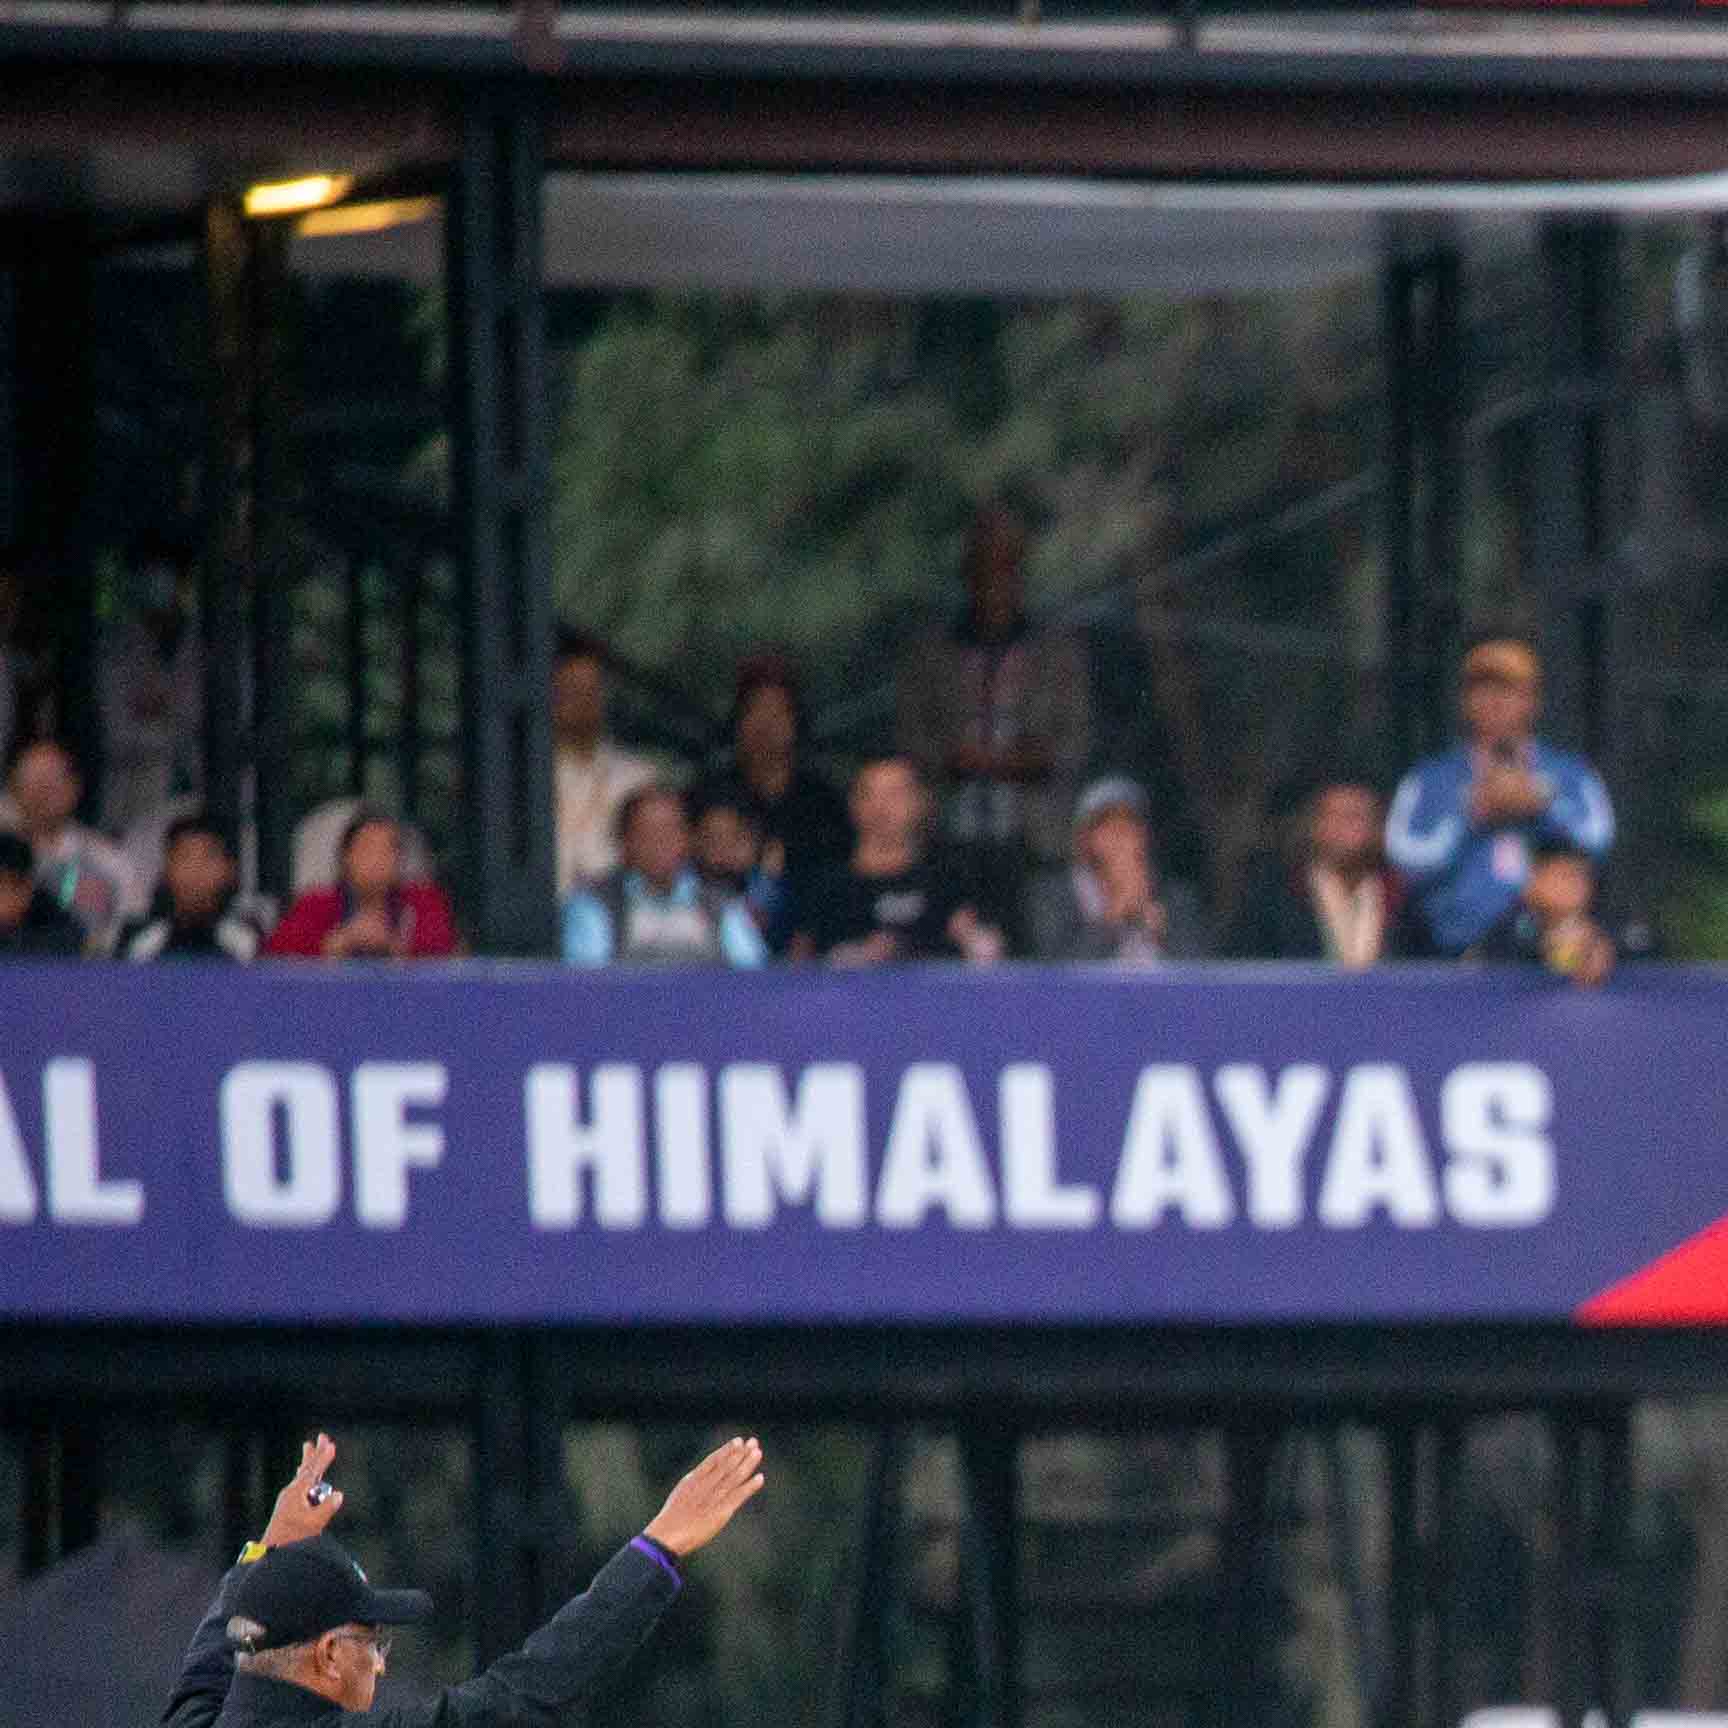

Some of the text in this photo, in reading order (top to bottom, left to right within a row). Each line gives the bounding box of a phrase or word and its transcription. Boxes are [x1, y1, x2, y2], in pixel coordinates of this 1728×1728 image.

[0, 1060, 1555, 1228] L OF HIMALAYAS
